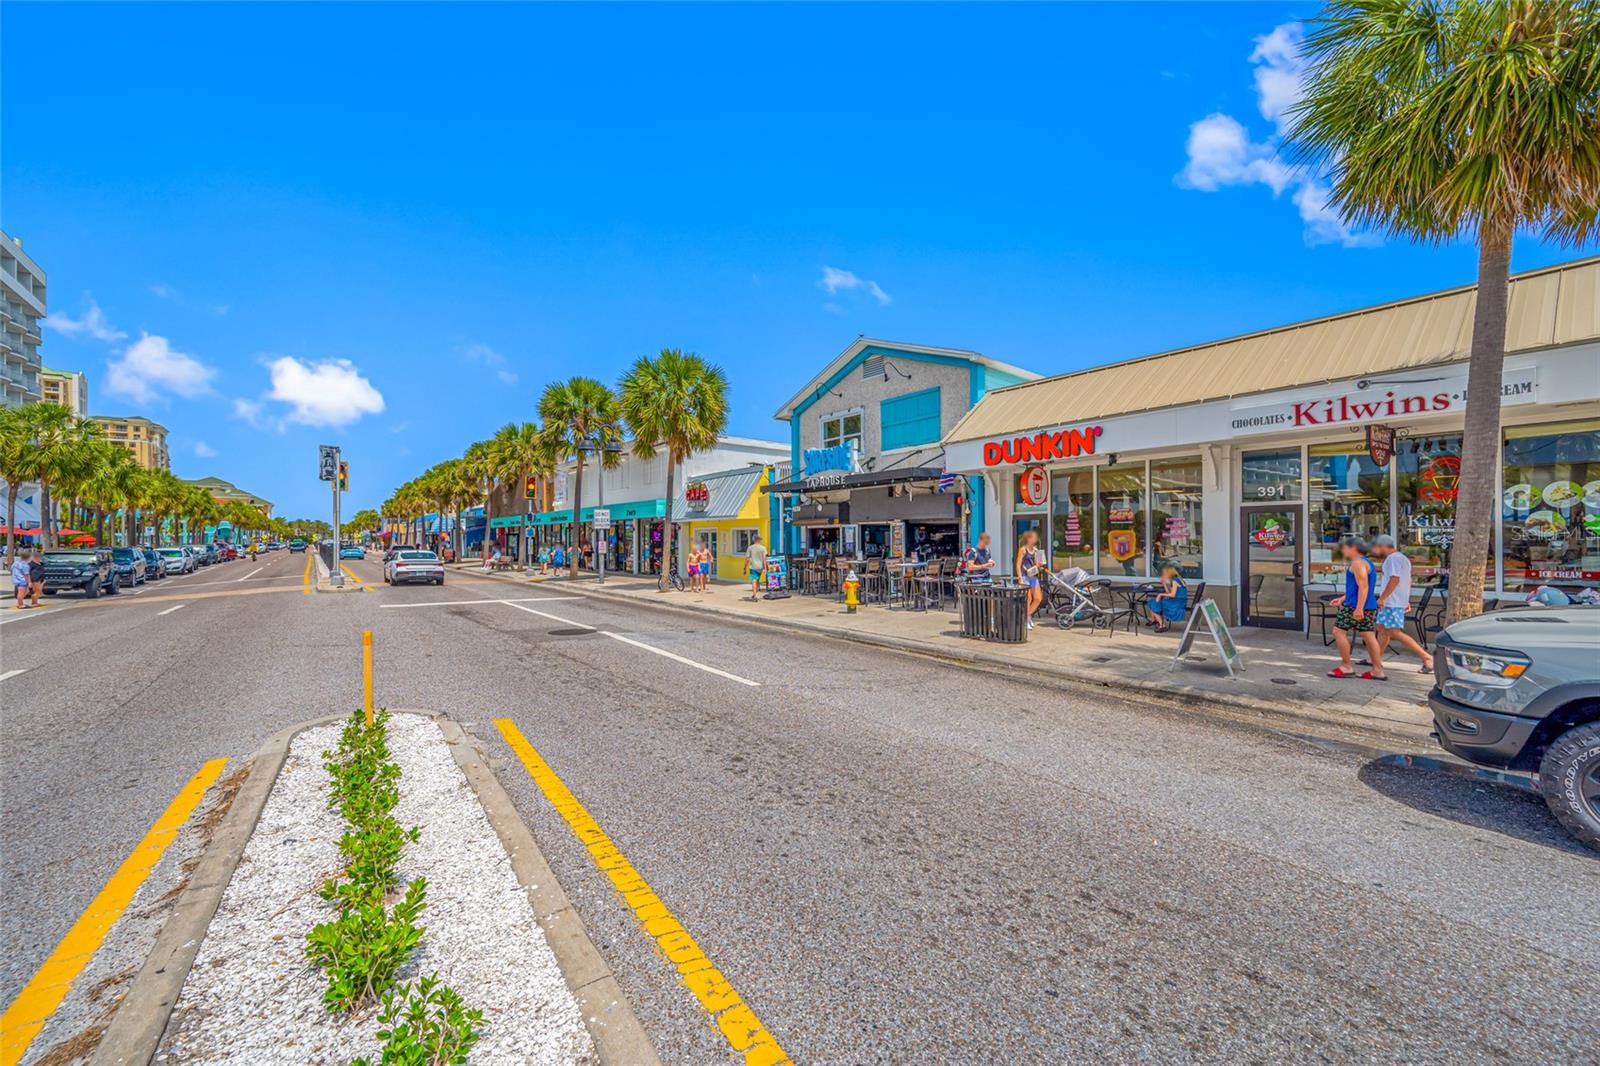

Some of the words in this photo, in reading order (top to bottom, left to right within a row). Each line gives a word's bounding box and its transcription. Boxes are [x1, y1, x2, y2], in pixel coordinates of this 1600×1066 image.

[1231, 413, 1285, 429] CHOCOLATES
[1292, 392, 1450, 427] Kilwins
[806, 475, 846, 488] TAPHOUSE
[1257, 484, 1284, 497] 391
[1407, 513, 1456, 527] Kilw
[1538, 570, 1552, 578] ICE
[1554, 570, 1583, 579] CREAM
